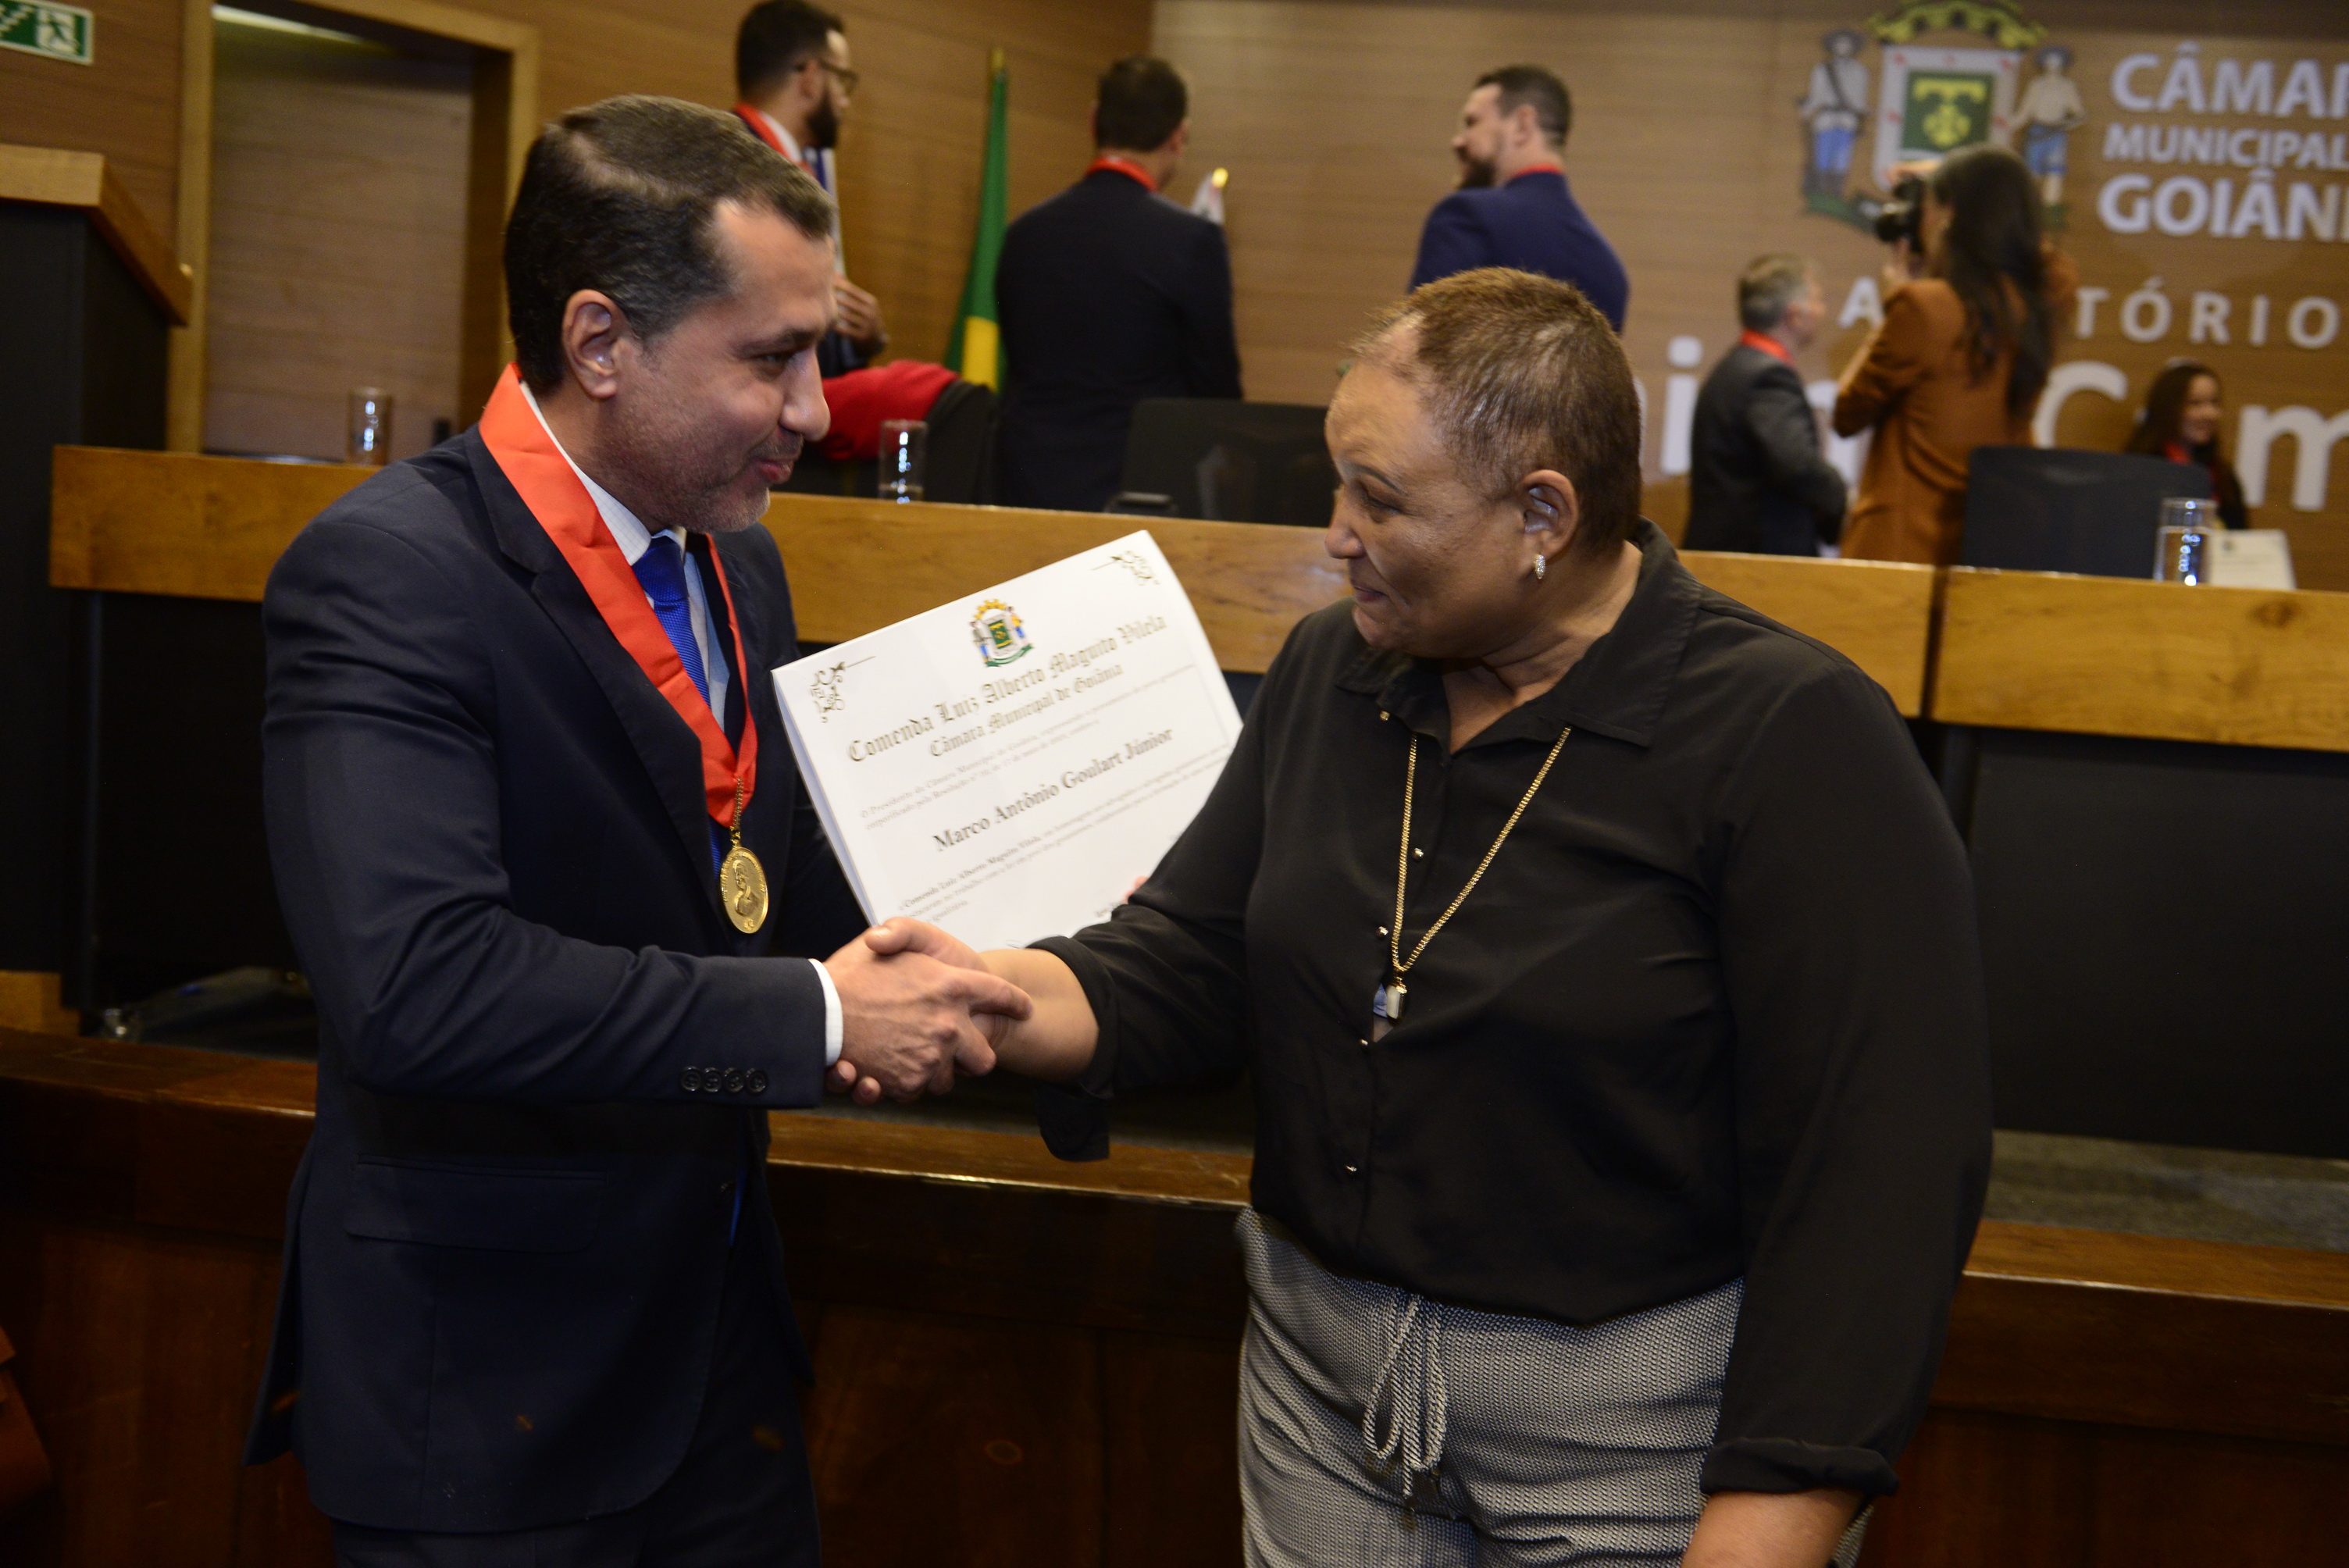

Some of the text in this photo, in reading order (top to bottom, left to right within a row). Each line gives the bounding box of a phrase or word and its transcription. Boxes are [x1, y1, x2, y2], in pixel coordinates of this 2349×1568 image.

[847, 615, 1167, 762] Comenda Luiz Alberto Maguito Vilela
[930, 725, 985, 757] Câmara
[989, 692, 1055, 732] Municipal
[1055, 688, 1071, 701] de
[1074, 664, 1124, 693] Goiânia
[932, 818, 990, 852] Marco
[995, 783, 1060, 824] Antônio
[1061, 752, 1123, 789] Goulart
[1124, 729, 1173, 760] Júnior
